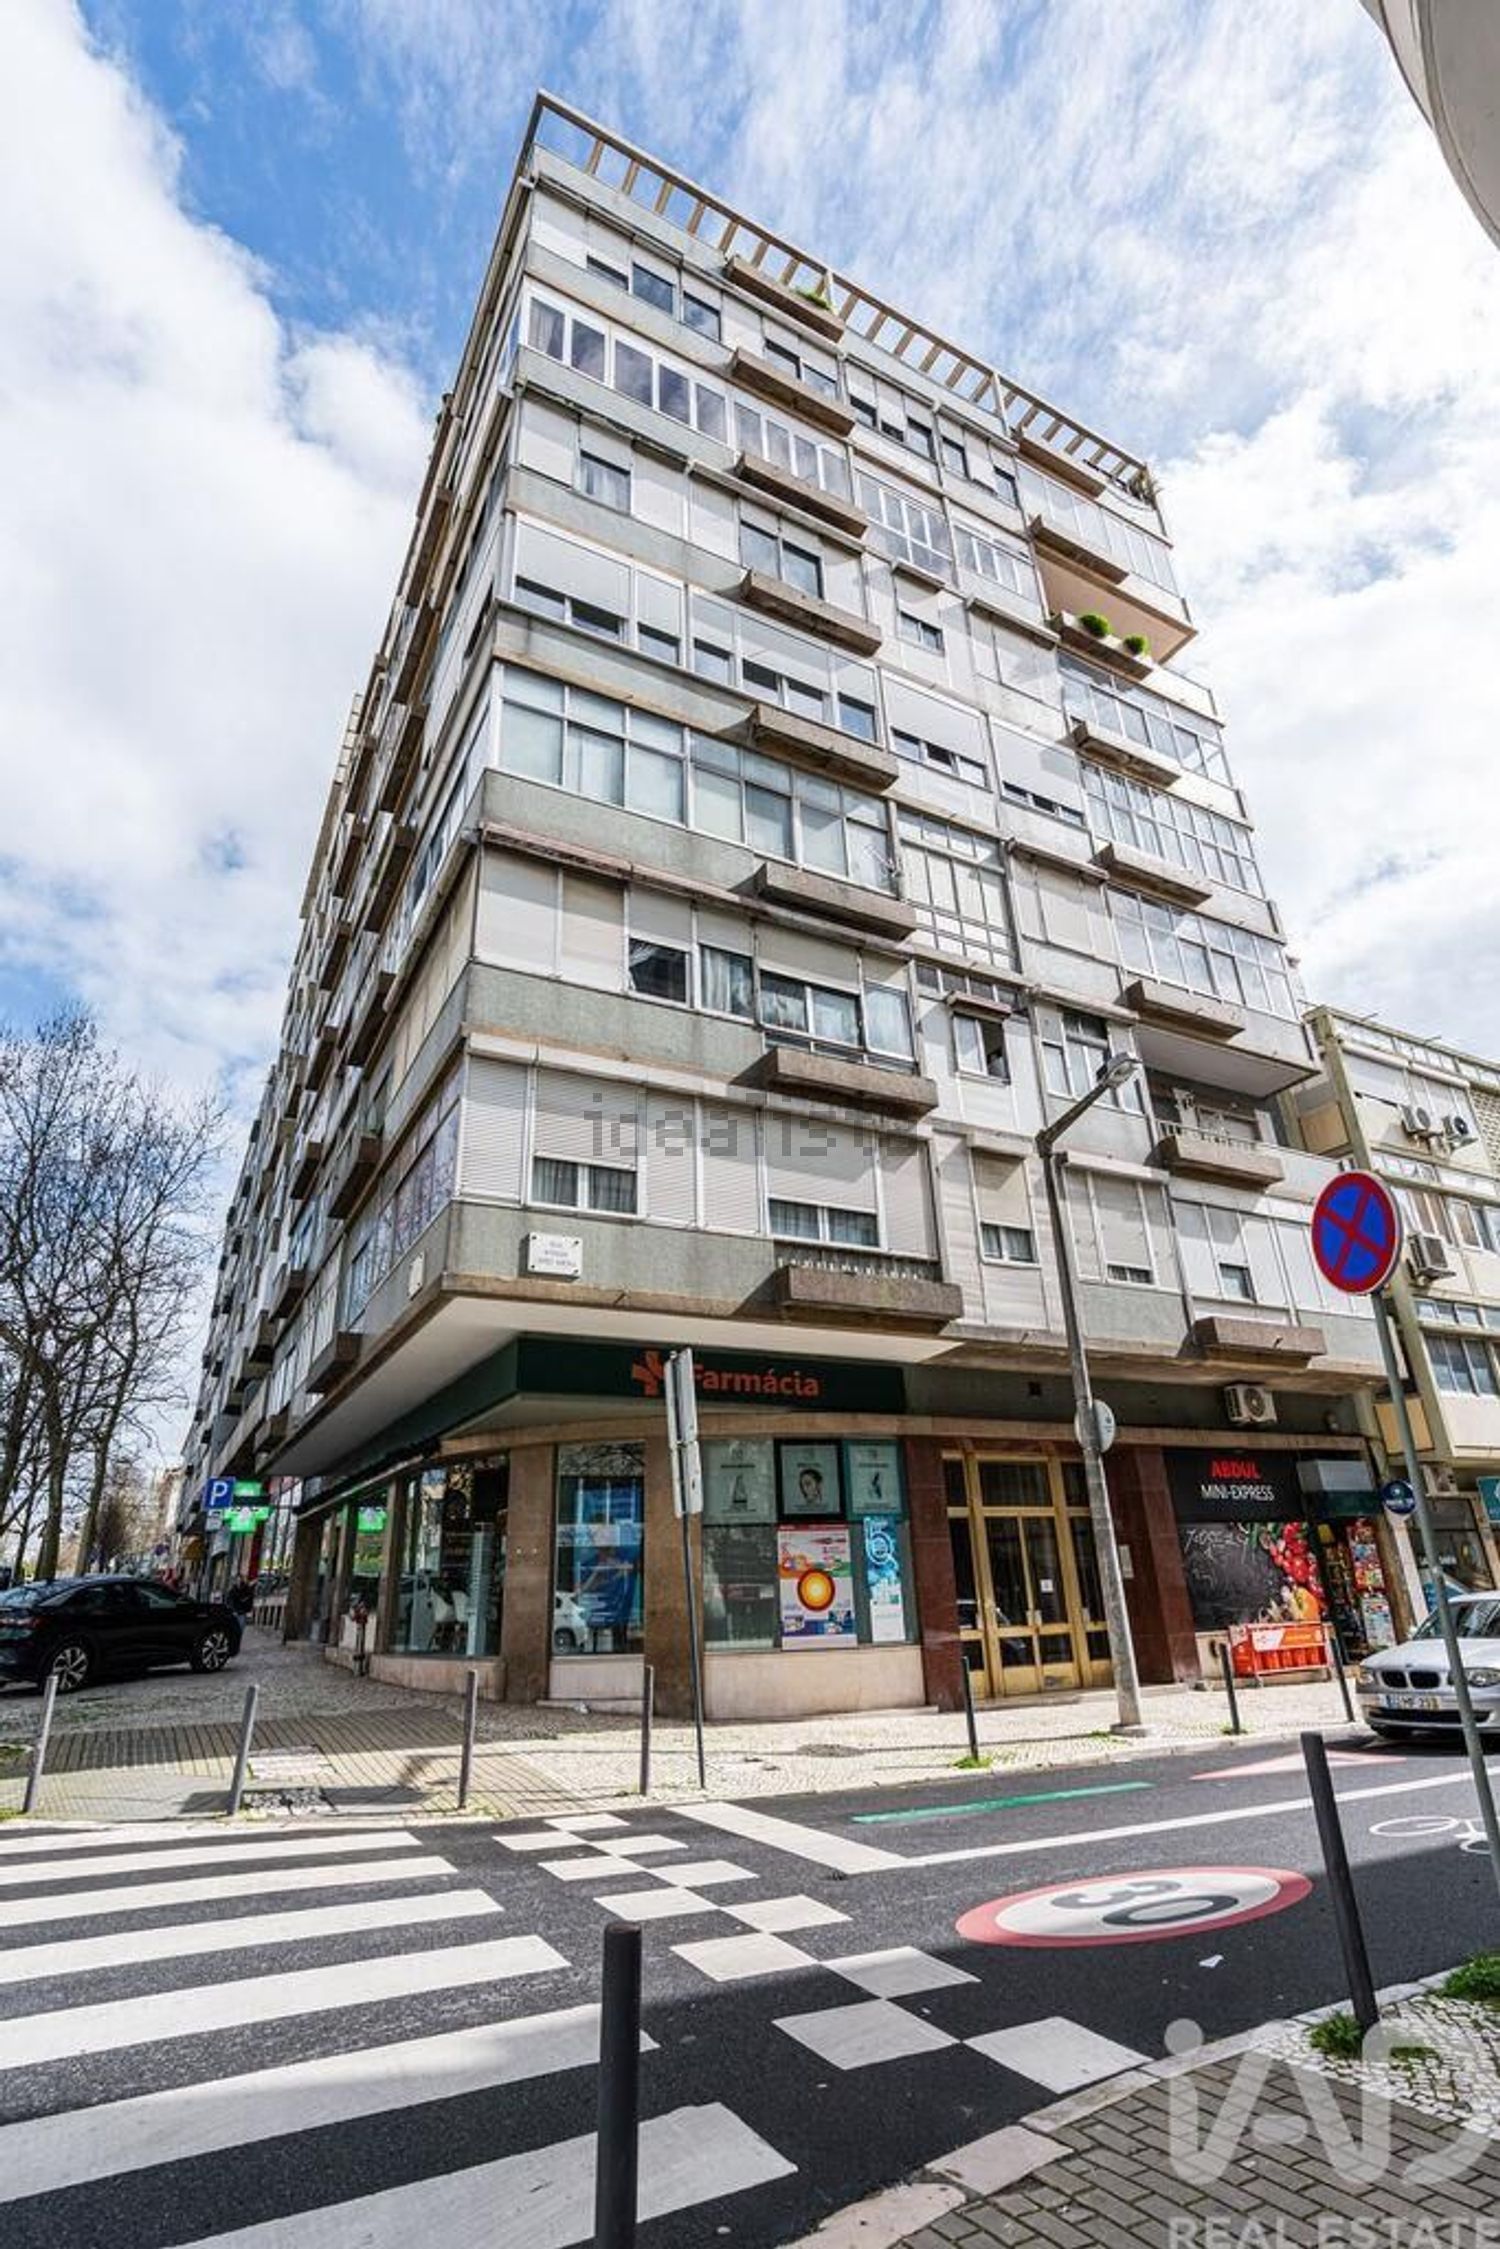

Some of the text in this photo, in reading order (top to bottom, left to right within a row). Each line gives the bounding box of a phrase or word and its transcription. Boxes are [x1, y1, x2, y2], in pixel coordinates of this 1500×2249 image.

[1211, 1461, 1261, 1478] ABDUL
[210, 1481, 229, 1506] P
[1200, 1484, 1275, 1501] MINI-EXPRESS
[1051, 1880, 1239, 1926] 30
